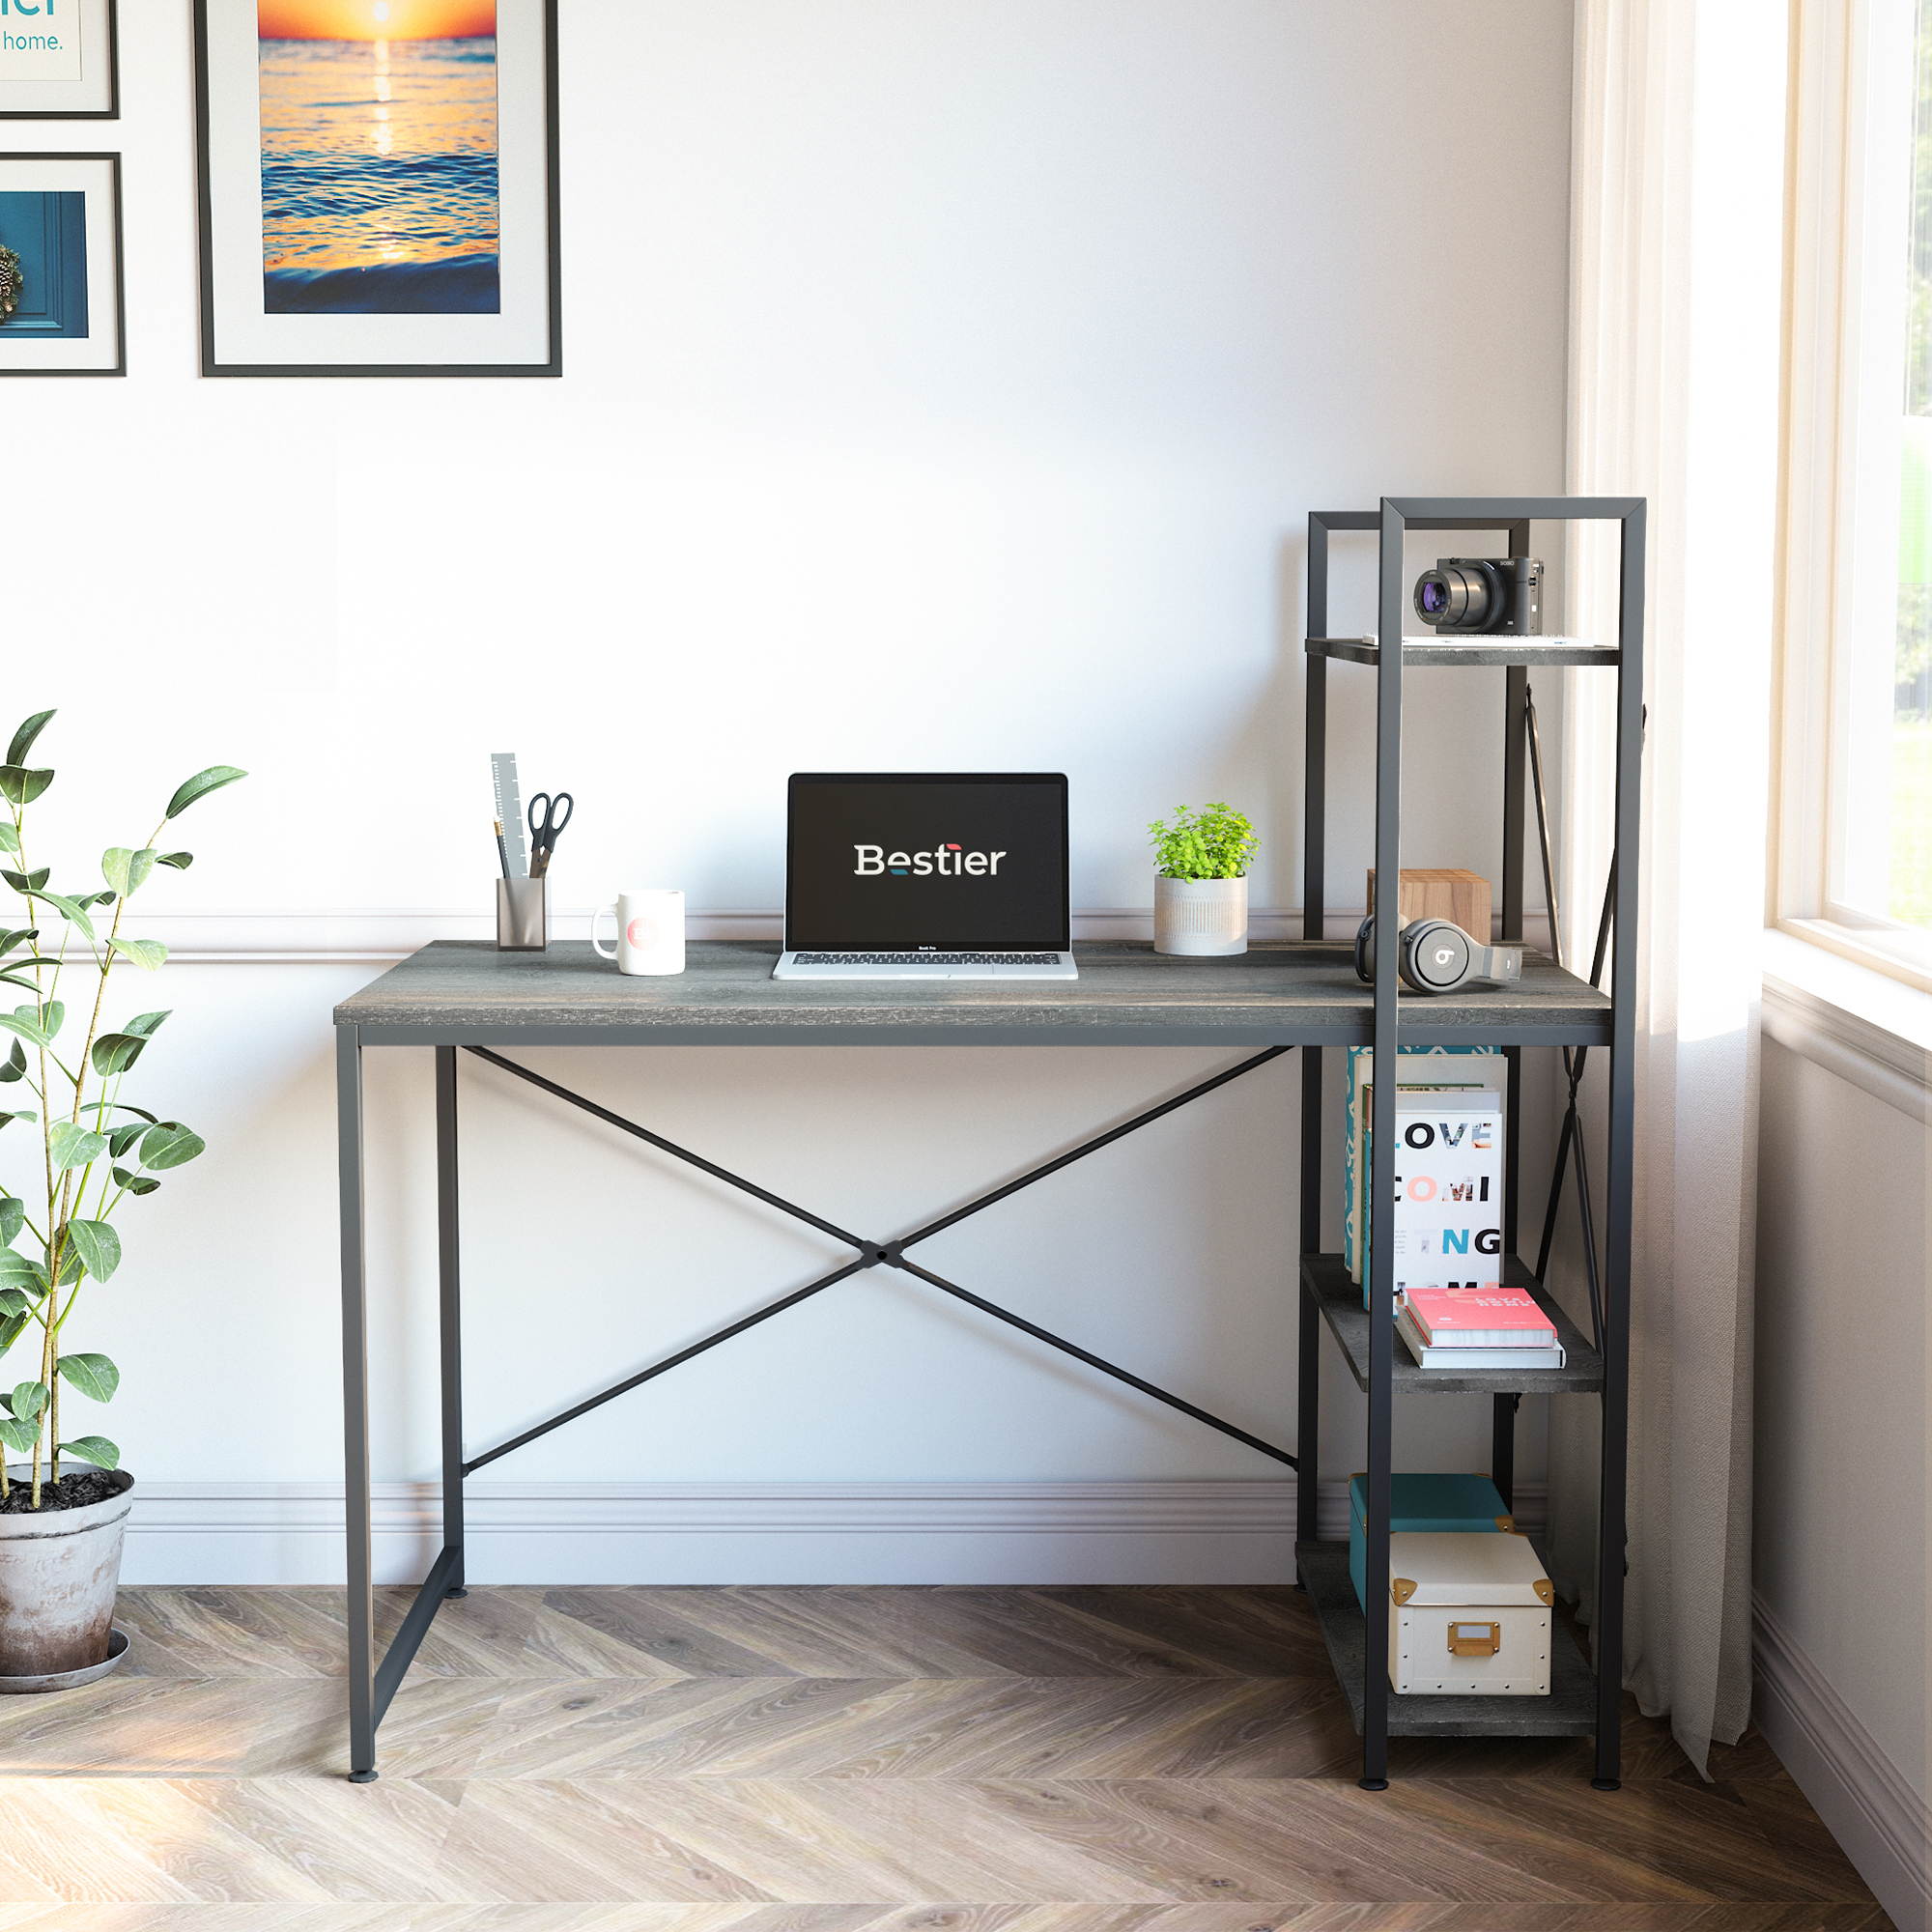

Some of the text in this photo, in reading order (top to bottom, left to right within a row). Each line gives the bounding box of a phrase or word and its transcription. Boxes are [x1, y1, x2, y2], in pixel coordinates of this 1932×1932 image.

[4, 31, 63, 49] home.
[854, 843, 1007, 875] Bestier
[1395, 1122, 1492, 1150] OVE
